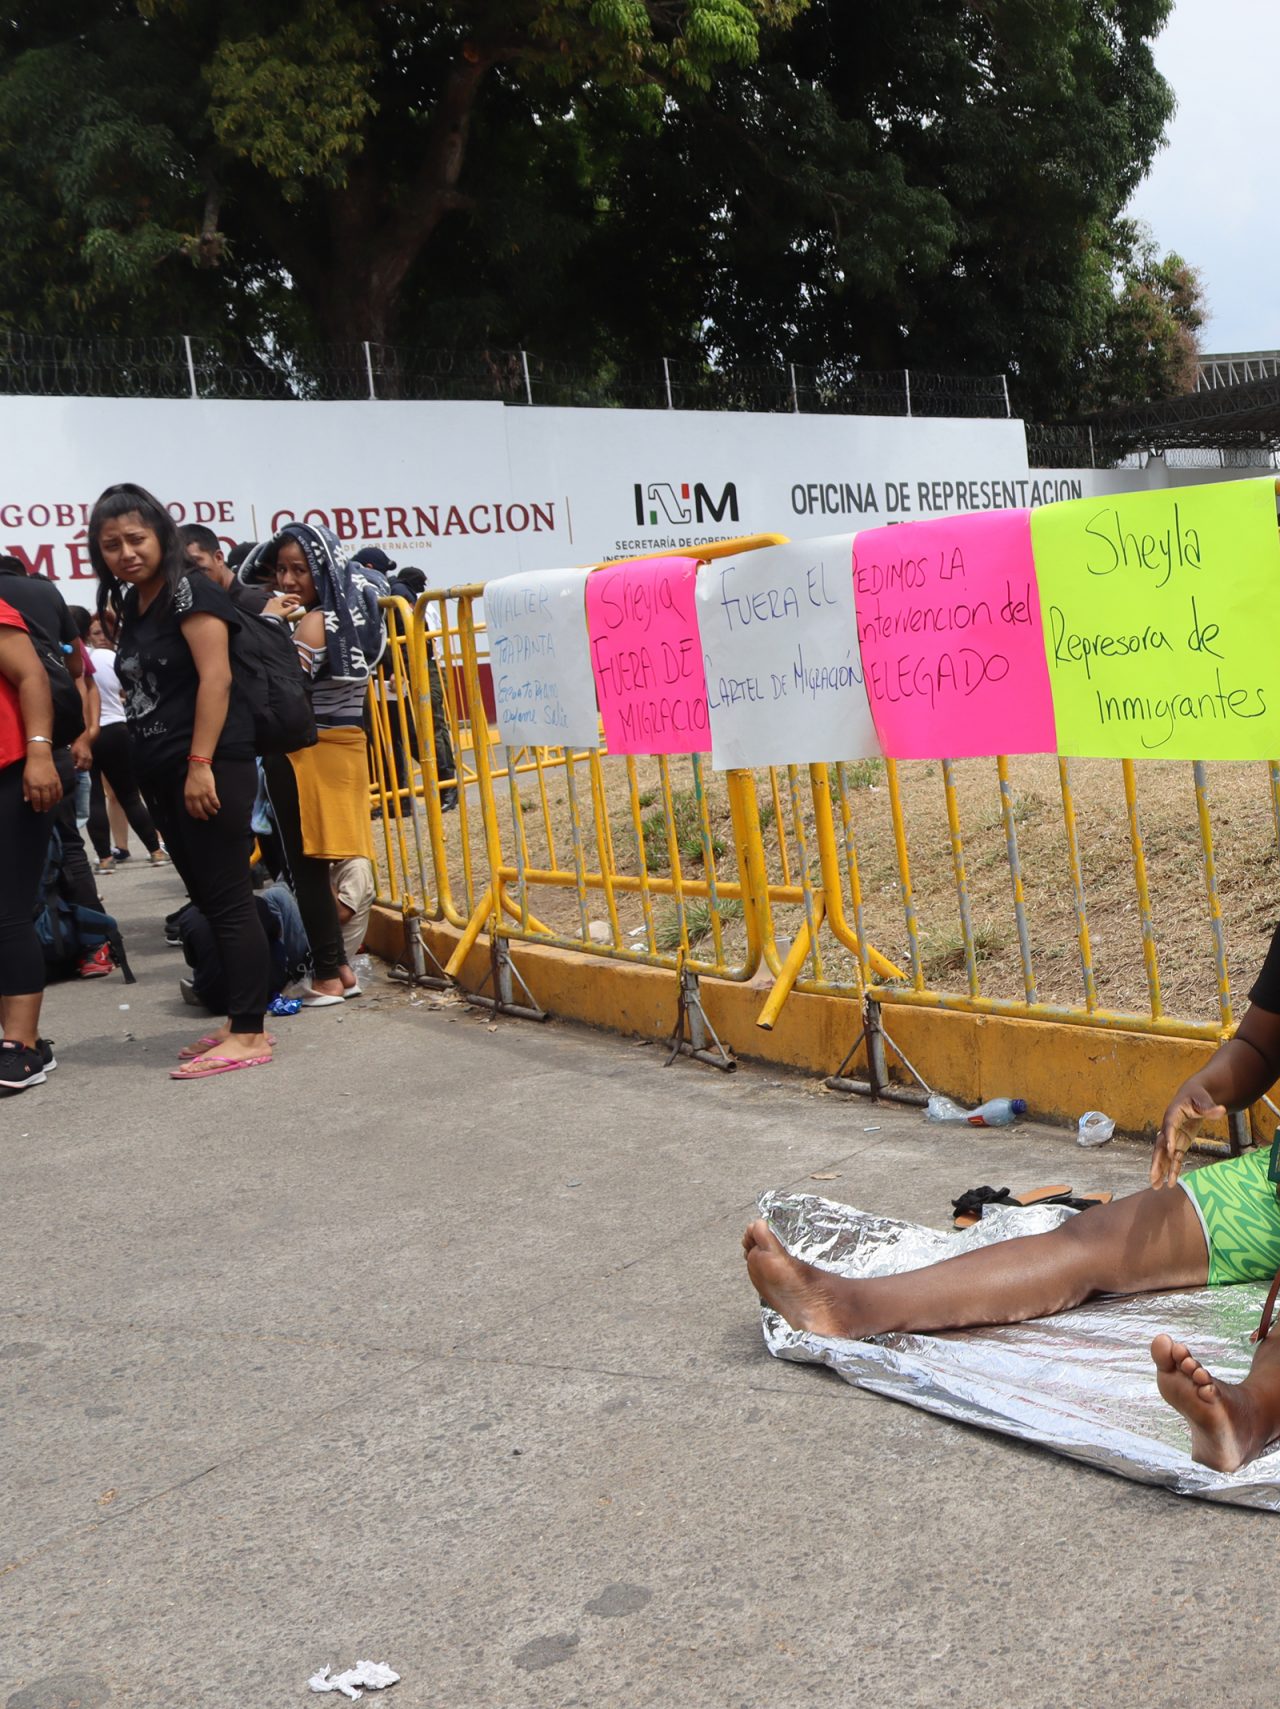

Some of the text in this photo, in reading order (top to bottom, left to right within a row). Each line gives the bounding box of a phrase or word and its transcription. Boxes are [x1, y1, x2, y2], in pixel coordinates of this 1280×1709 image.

[1, 500, 236, 528] GOBIO DE
[791, 479, 1083, 515] OFICINA DE REPRESENTACION
[615, 535, 677, 551] SECRETARÍA
[678, 537, 693, 548] DE
[940, 547, 966, 581] LA
[1085, 502, 1202, 588] Sheyla
[600, 562, 688, 632] Sheyla
[721, 566, 800, 632] FUERA
[1000, 580, 1034, 626] del
[593, 635, 657, 699] FUERA
[661, 637, 694, 685] DE
[1049, 595, 1225, 681] Represora de
[704, 653, 765, 709] CARTEL
[770, 673, 788, 700] DE
[863, 648, 1010, 710] ELEGADO
[1096, 667, 1267, 749] Inmigrantes
[618, 696, 711, 743] MIGRACIO
